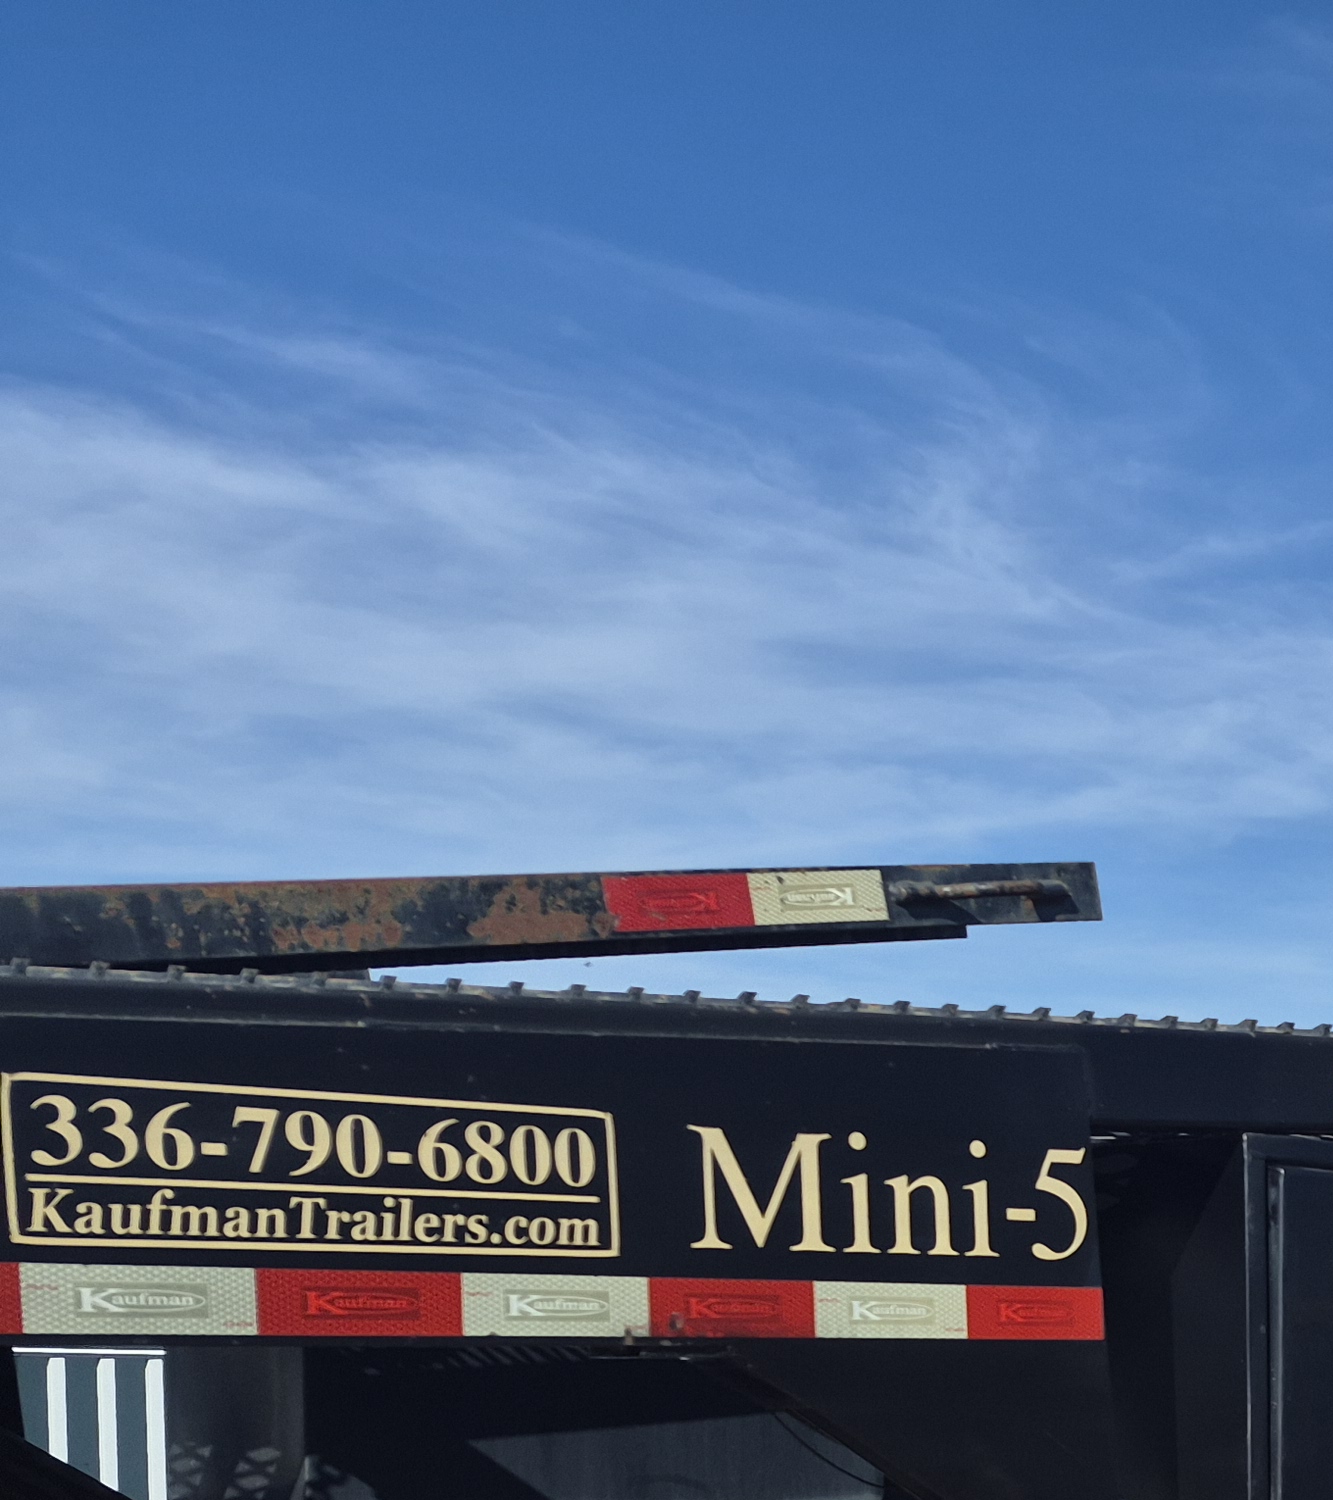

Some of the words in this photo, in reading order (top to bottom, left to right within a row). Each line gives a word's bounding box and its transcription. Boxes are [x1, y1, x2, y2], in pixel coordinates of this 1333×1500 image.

[30, 1094, 597, 1187] 336-790-6800
[687, 1124, 1088, 1261] Mini-5
[27, 1187, 600, 1247] KaufmanTrailers.com
[76, 1286, 196, 1314] Kaufman
[508, 1294, 601, 1317] Kaufman
[851, 1300, 928, 1321] Kaufman
